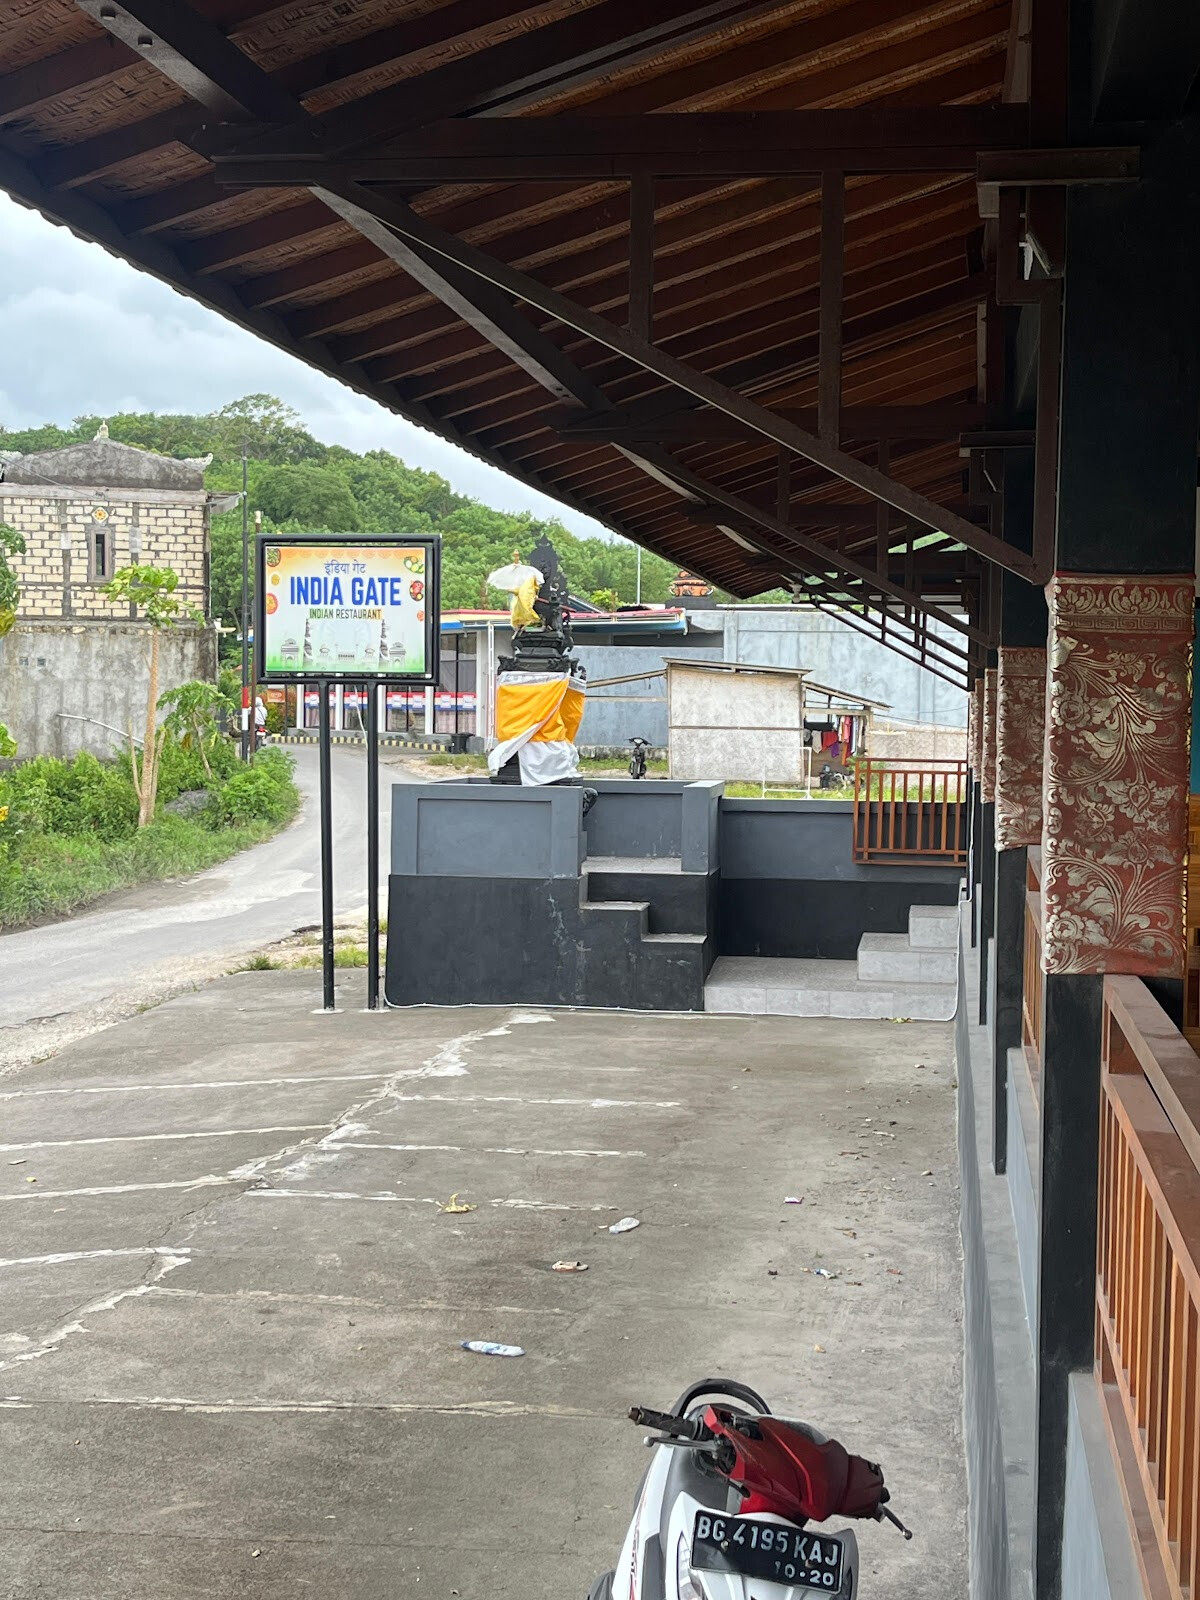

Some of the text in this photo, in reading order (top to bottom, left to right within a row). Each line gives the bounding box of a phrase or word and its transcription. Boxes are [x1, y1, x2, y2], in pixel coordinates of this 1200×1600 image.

[324, 559, 366, 575] इंडिया गेट
[290, 576, 401, 606] INDIA GATE
[309, 608, 381, 620] INDIAN RESTAURANT
[697, 1516, 839, 1566] BG 4195 KAJ
